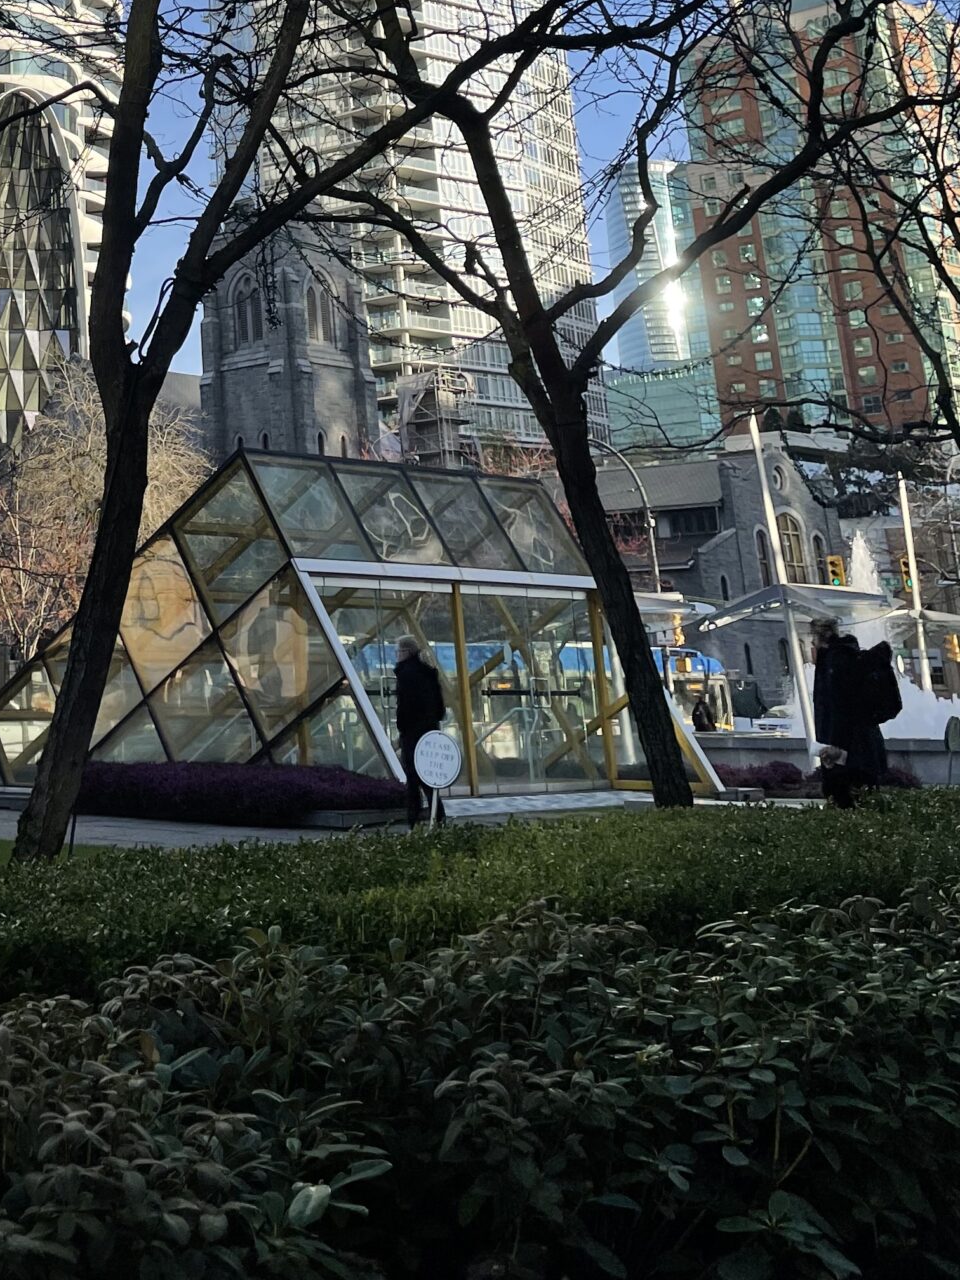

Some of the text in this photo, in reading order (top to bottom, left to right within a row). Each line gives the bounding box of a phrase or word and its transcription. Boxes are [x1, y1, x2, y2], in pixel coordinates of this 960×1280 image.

[425, 741, 450, 751] PLEASE
[420, 750, 454, 761] KEEP OFF
[430, 761, 443, 769] THE
[424, 770, 448, 780] GRASS
